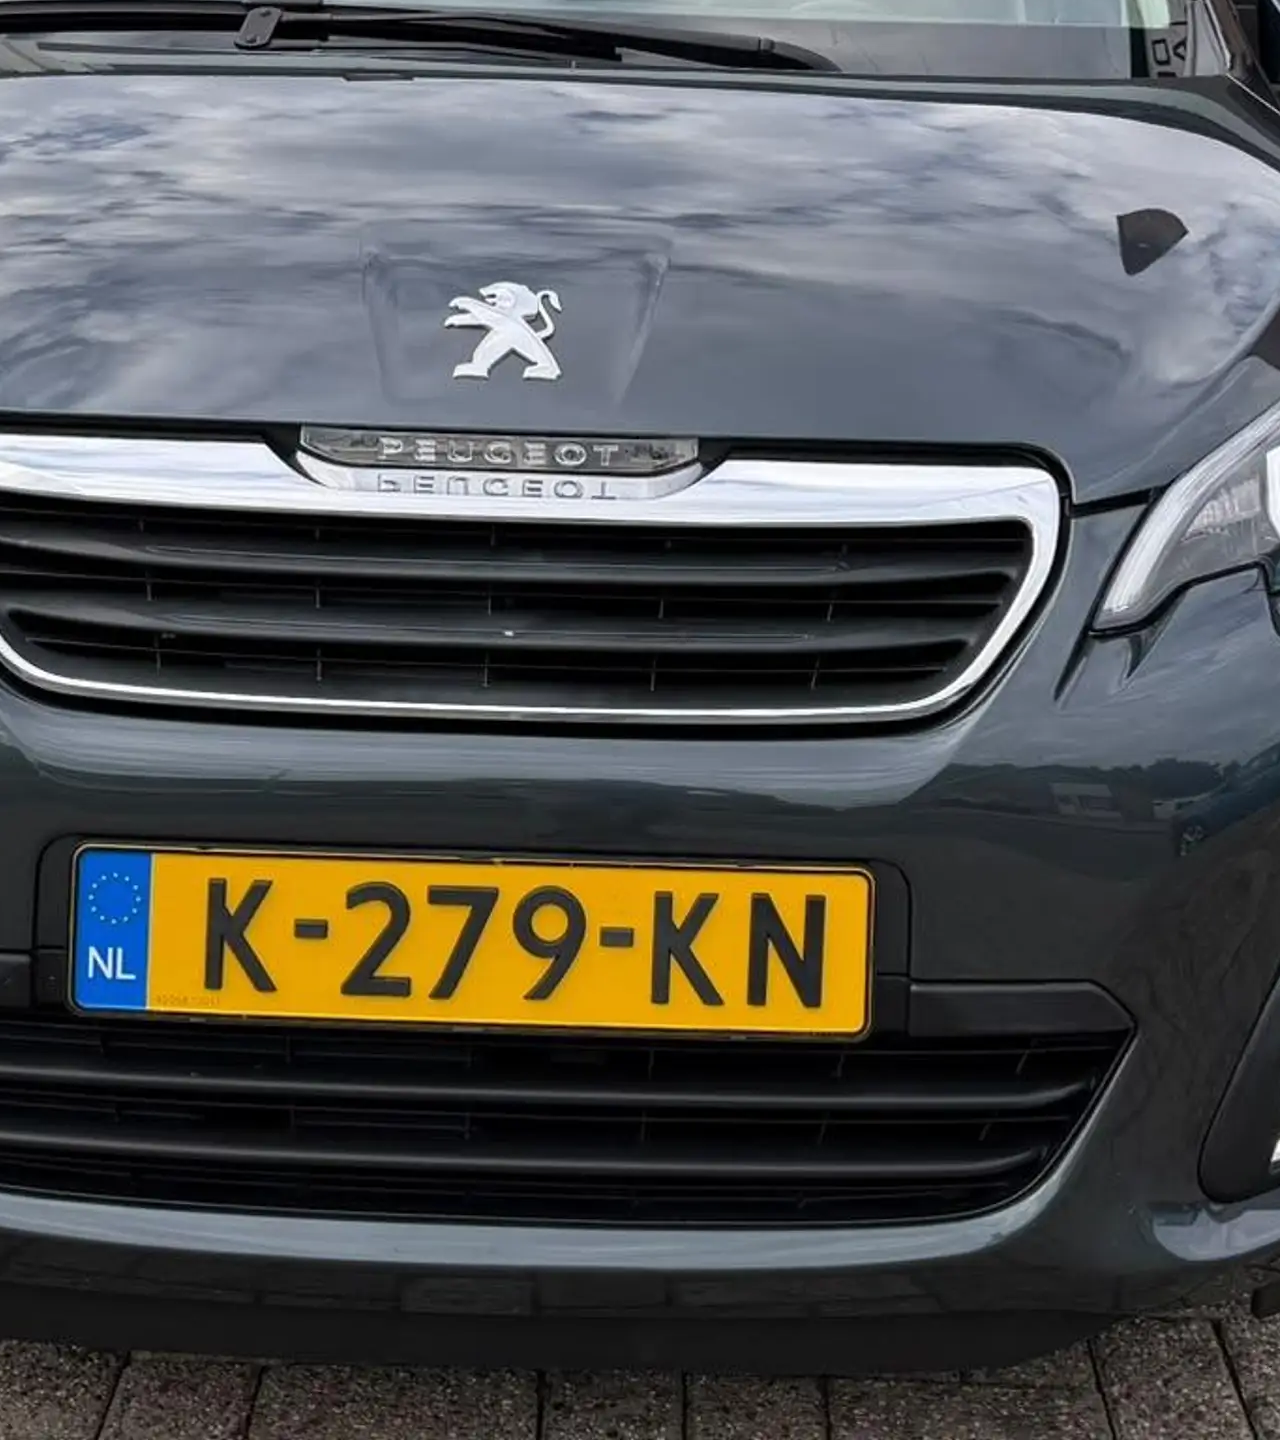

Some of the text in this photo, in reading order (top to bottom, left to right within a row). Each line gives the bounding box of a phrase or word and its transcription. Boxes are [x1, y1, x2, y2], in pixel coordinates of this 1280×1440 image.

[378, 437, 619, 467] PEUGEOT
[203, 876, 828, 1009] K-279-KN
[88, 946, 137, 980] NL
